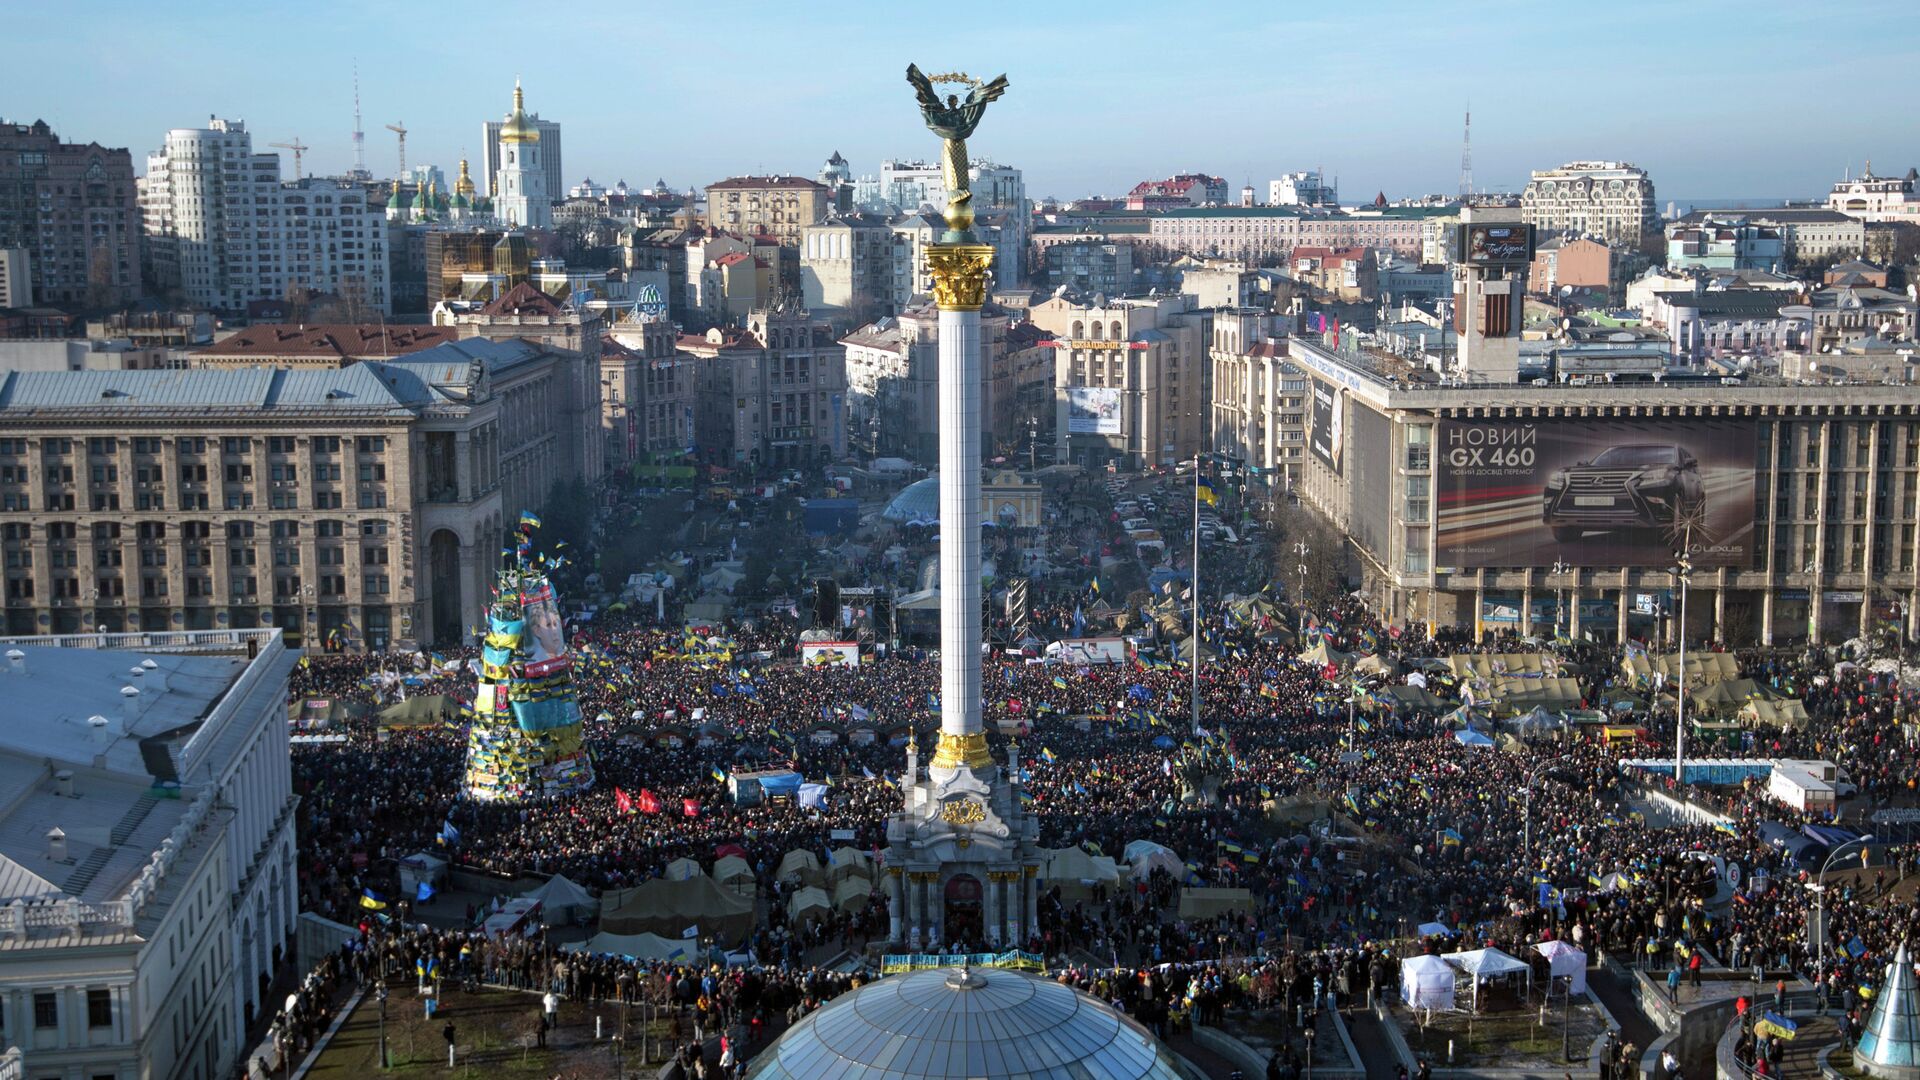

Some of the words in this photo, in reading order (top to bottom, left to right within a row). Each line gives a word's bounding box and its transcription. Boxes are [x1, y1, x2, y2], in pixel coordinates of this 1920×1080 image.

[1450, 424, 1536, 445] НОВИЙ
[1450, 447, 1484, 467] GX
[1489, 447, 1535, 467] 460
[1450, 468, 1475, 476] НОВИЙ
[1476, 468, 1503, 476] ДОСВІД
